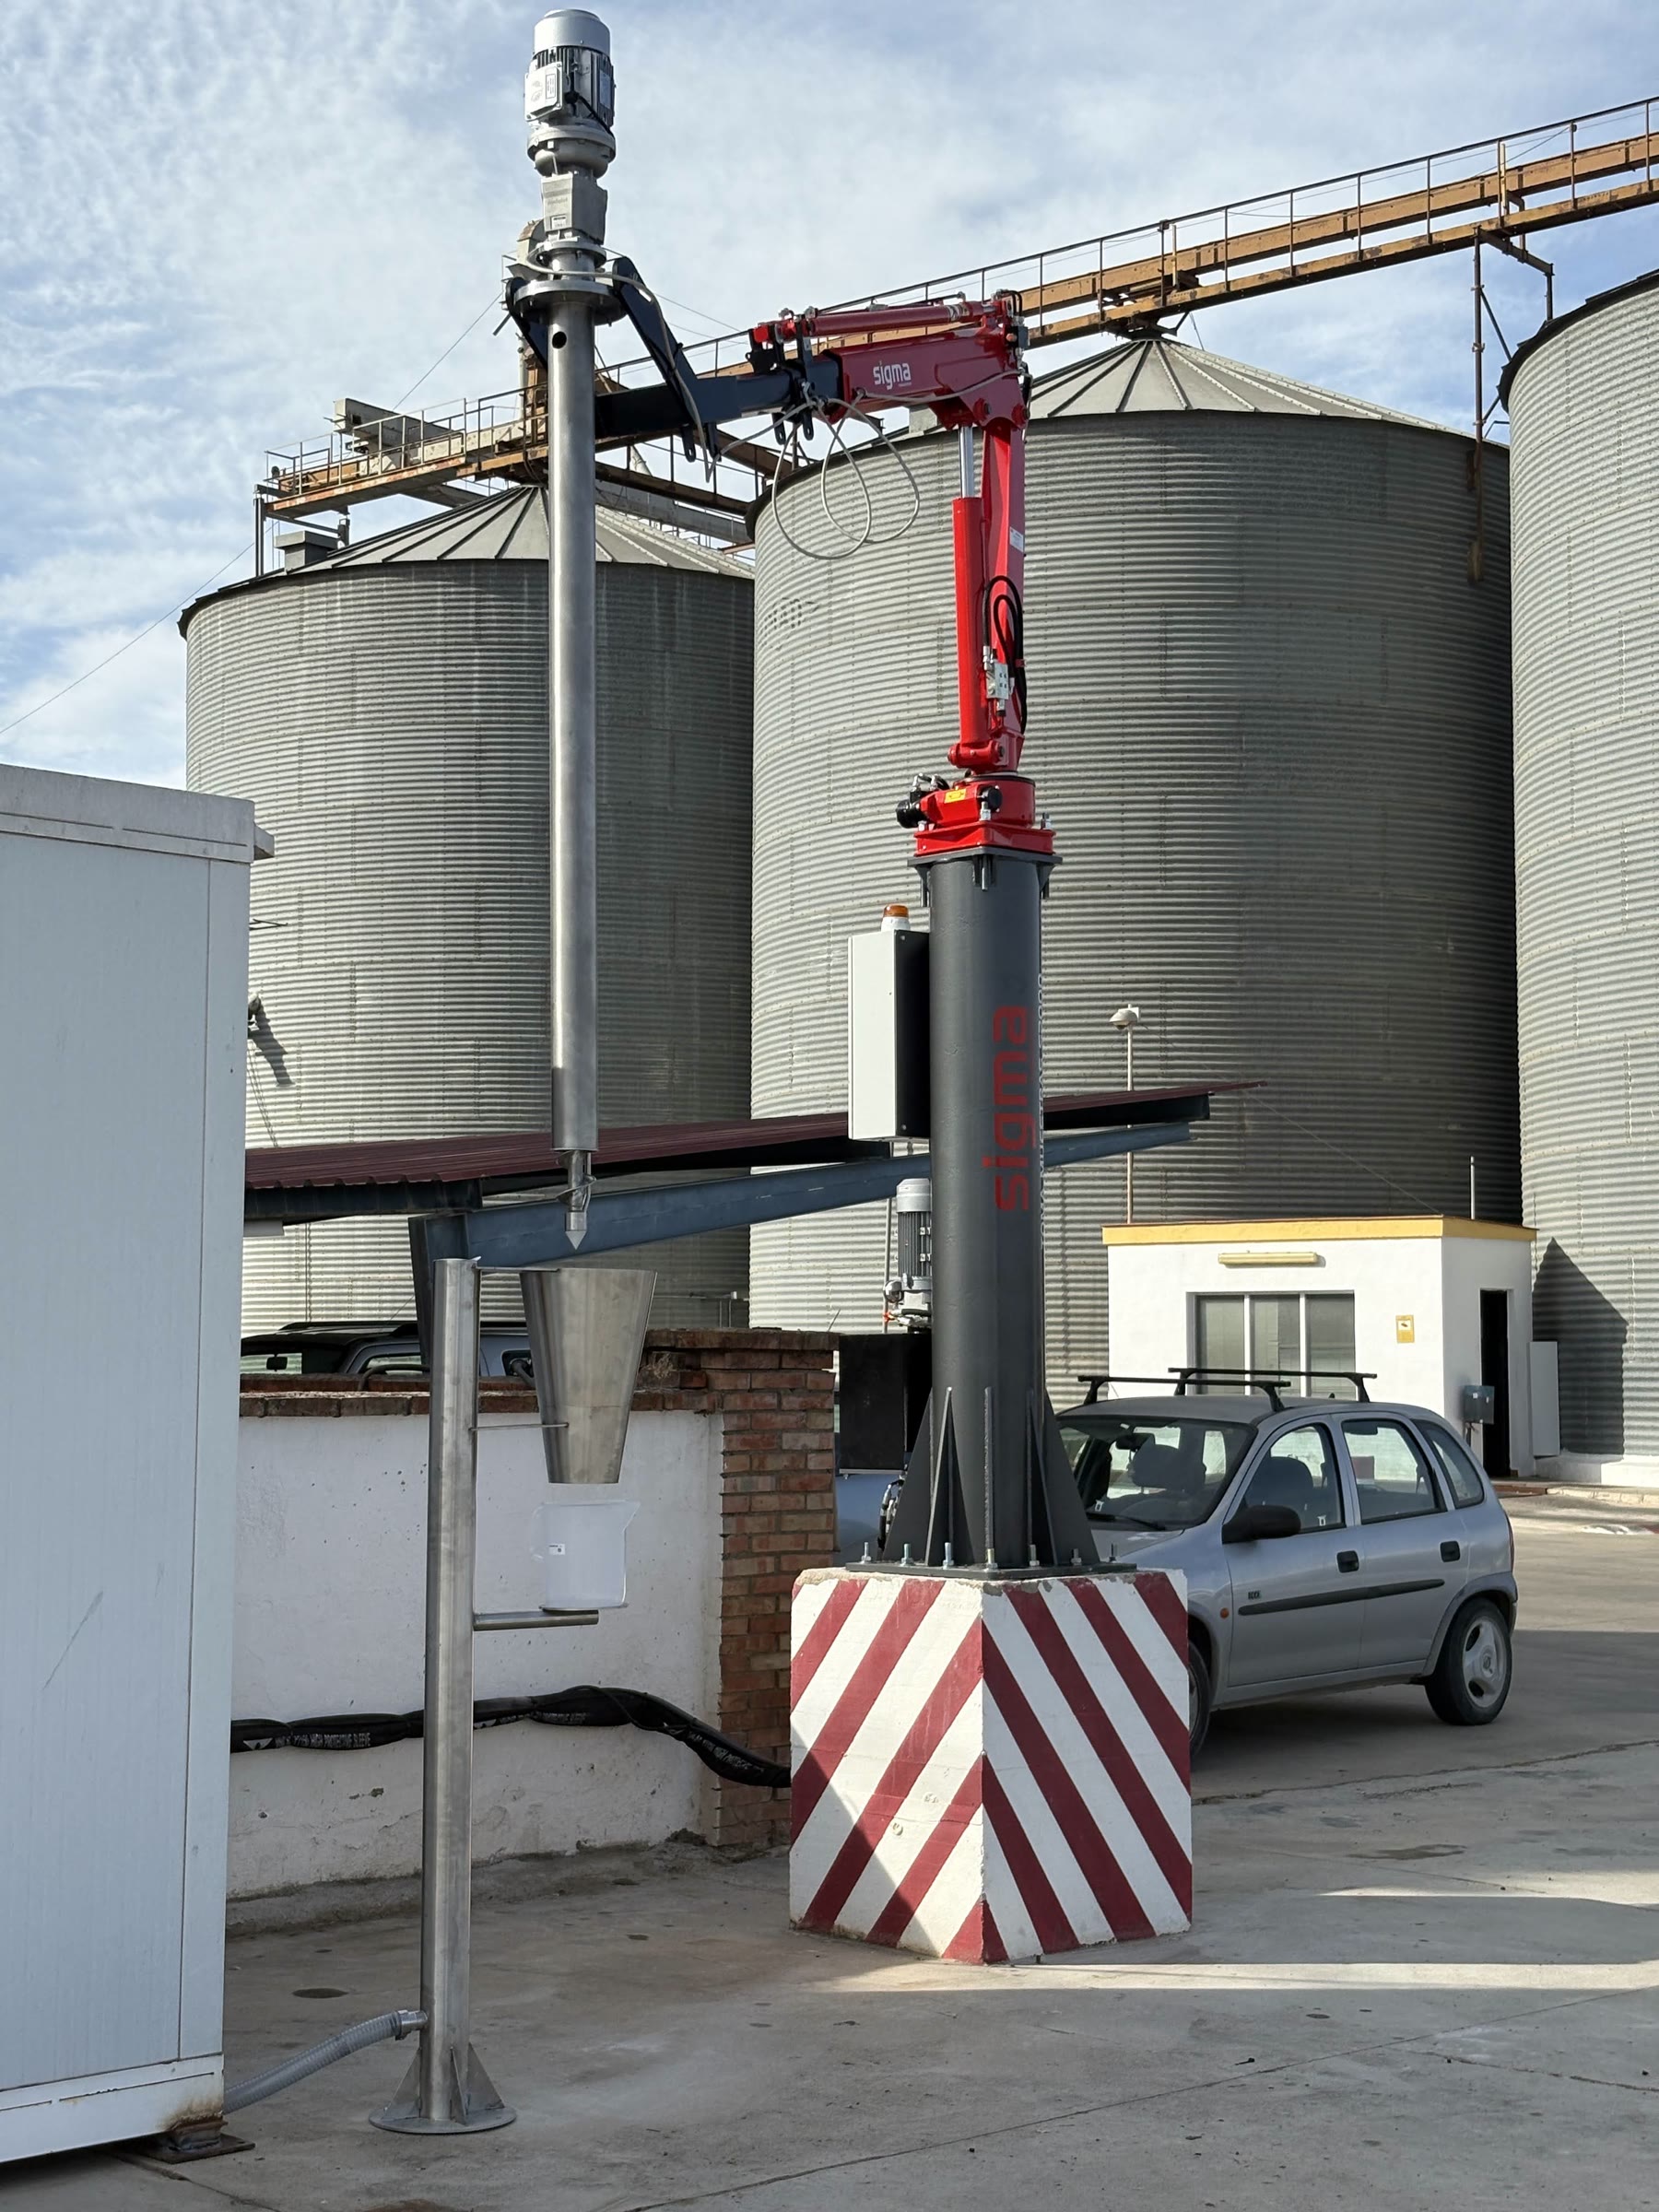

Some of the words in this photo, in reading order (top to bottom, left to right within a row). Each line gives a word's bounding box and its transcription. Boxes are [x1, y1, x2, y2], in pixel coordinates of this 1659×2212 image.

[873, 360, 912, 390] sigma
[982, 1006, 1036, 1210] sigma
[353, 1732, 371, 1747] SLEEVE
